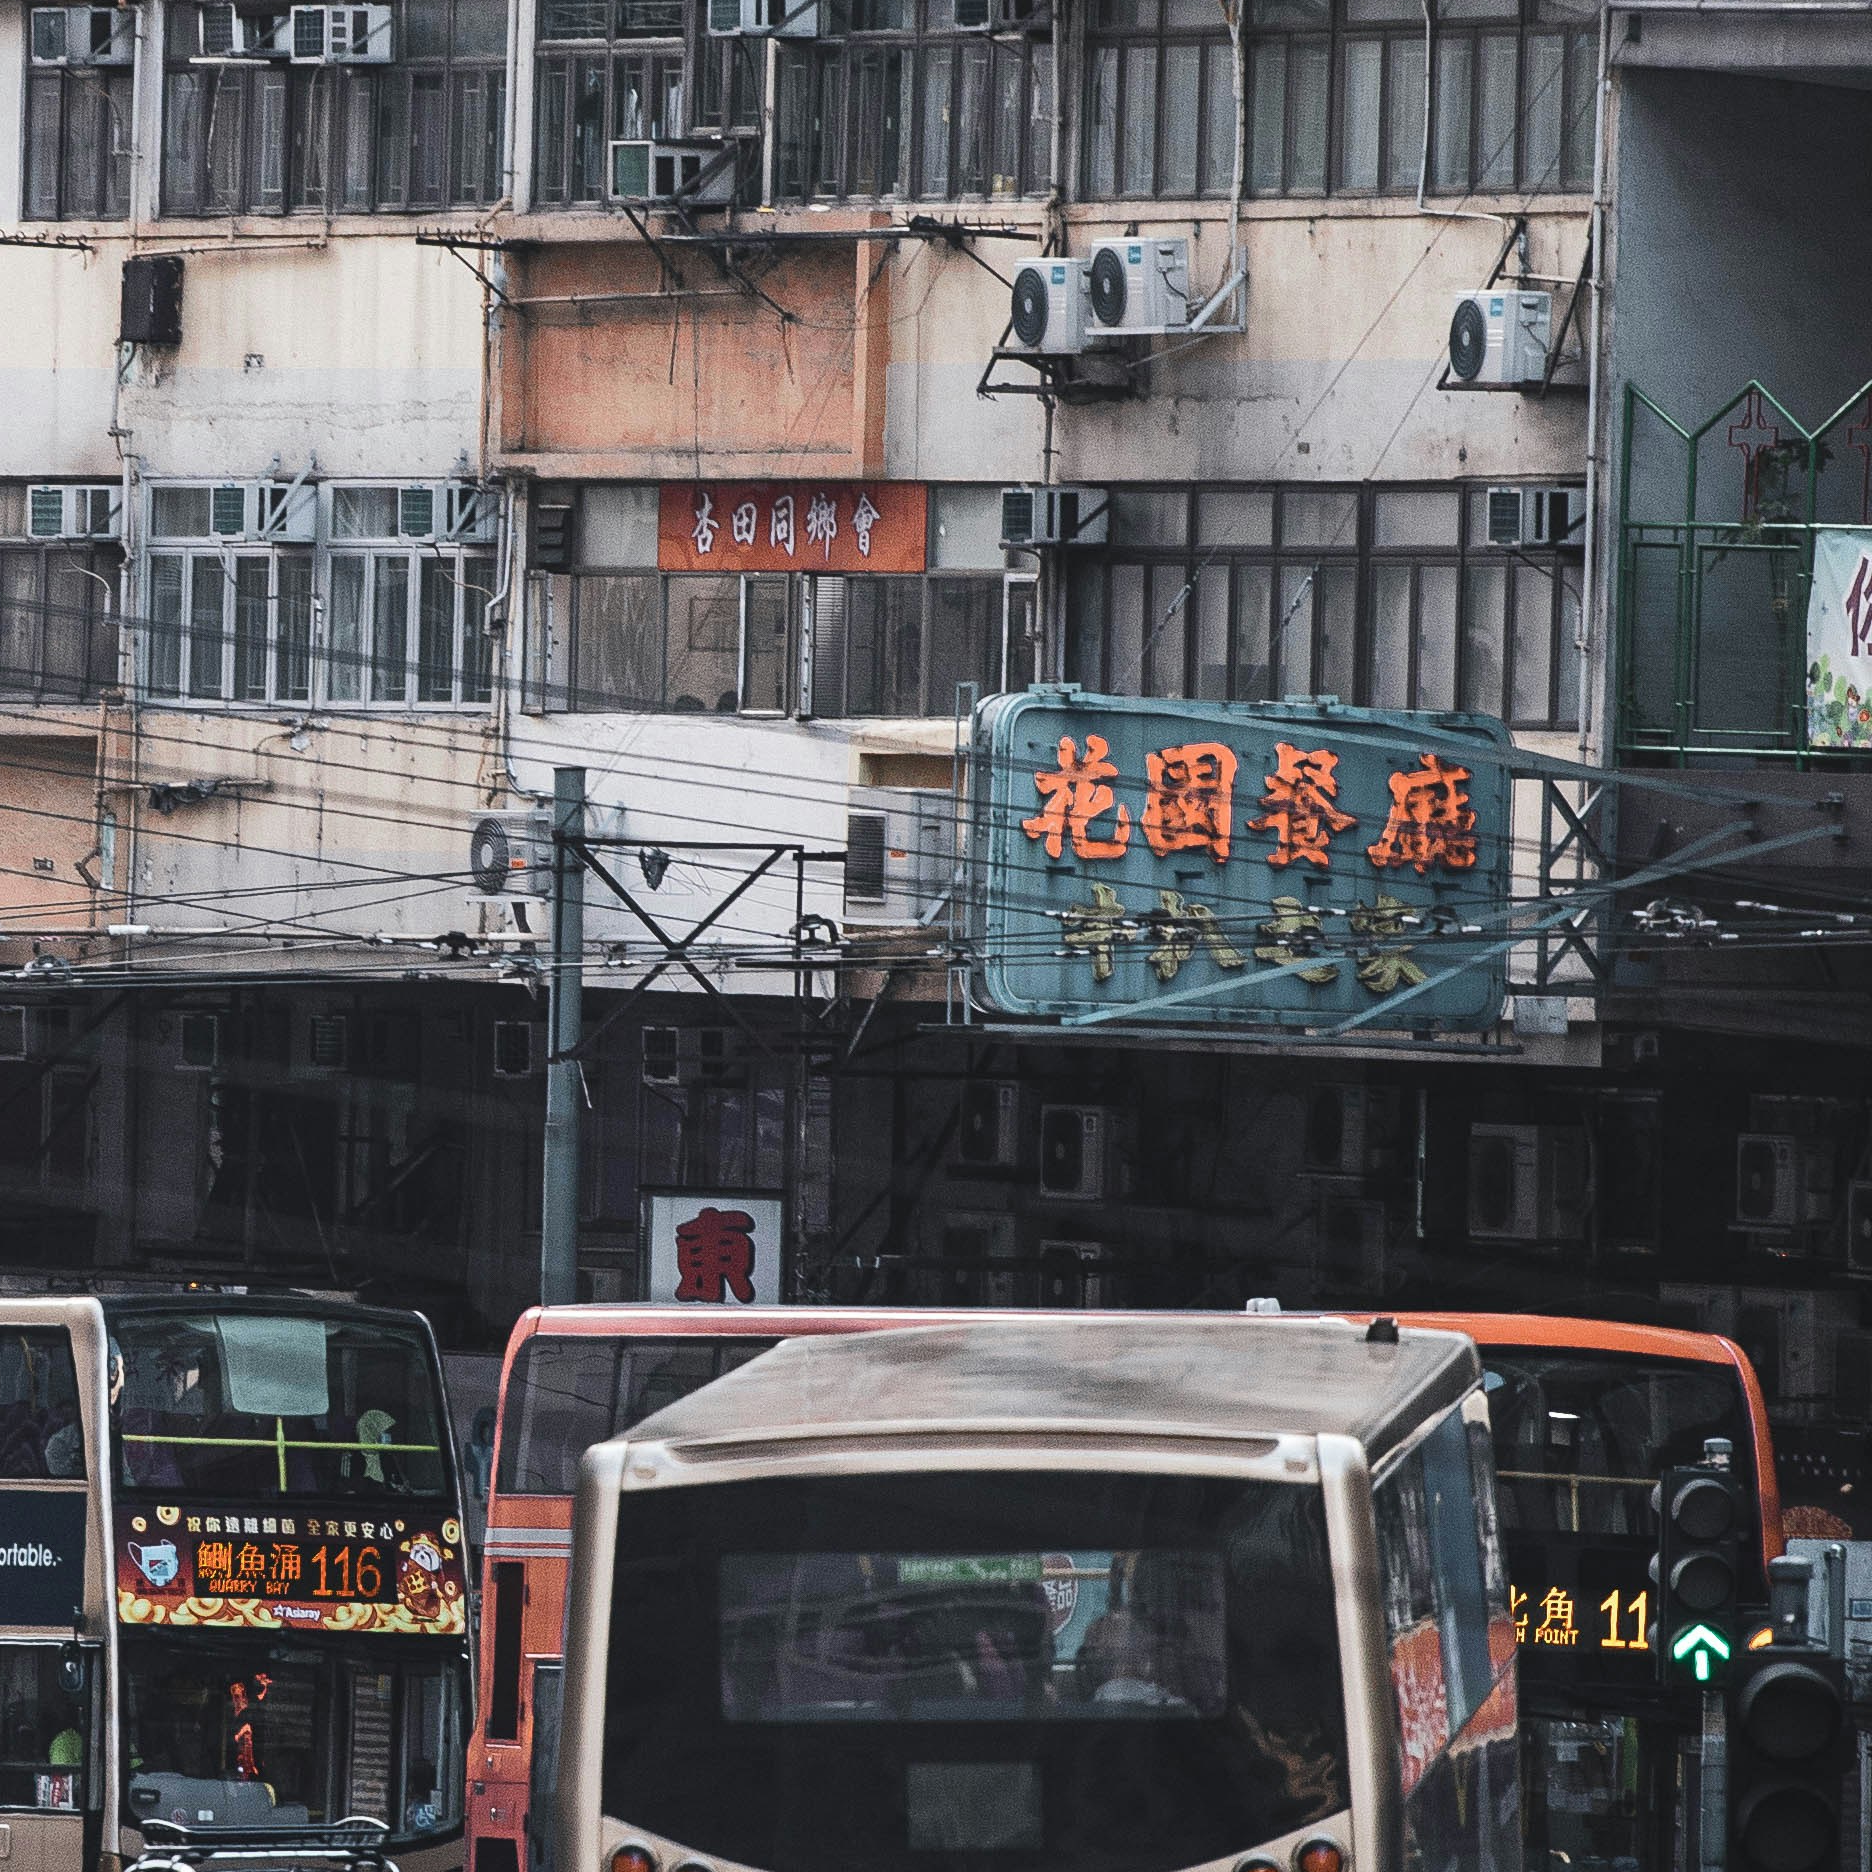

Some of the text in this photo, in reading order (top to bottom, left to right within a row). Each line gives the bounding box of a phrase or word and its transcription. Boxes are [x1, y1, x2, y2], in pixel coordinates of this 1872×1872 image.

[1021, 734, 1479, 875] 花園餐廳
[197, 1540, 382, 1600] 鰂魚涌 116
[208, 1579, 290, 1596] QUARRY BAY
[1534, 1627, 1580, 1646] POINT
